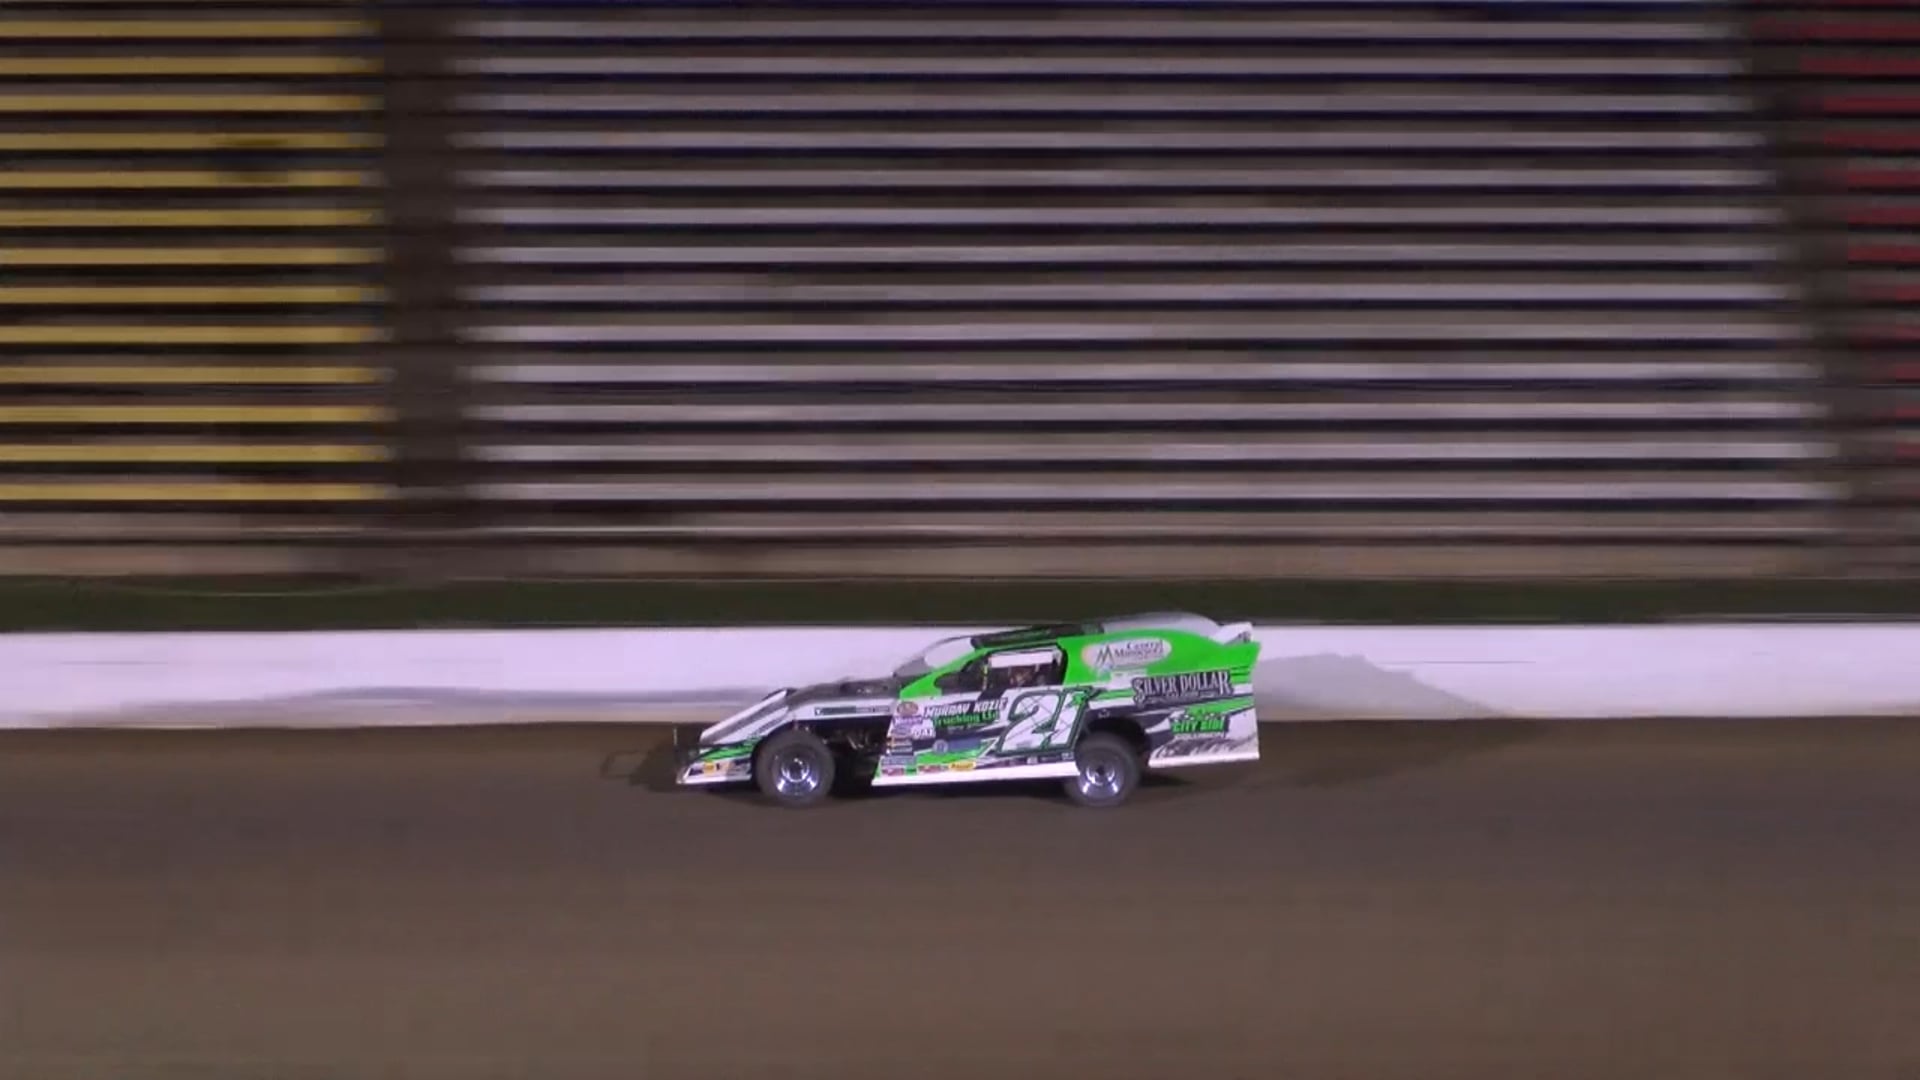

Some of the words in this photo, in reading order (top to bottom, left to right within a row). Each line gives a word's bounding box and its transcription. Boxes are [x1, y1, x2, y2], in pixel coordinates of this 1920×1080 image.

[1132, 676, 1178, 702] SILVER
[1180, 671, 1231, 696] DOLLAR
[997, 687, 1091, 757] 21
[1172, 720, 1199, 733] CITY
